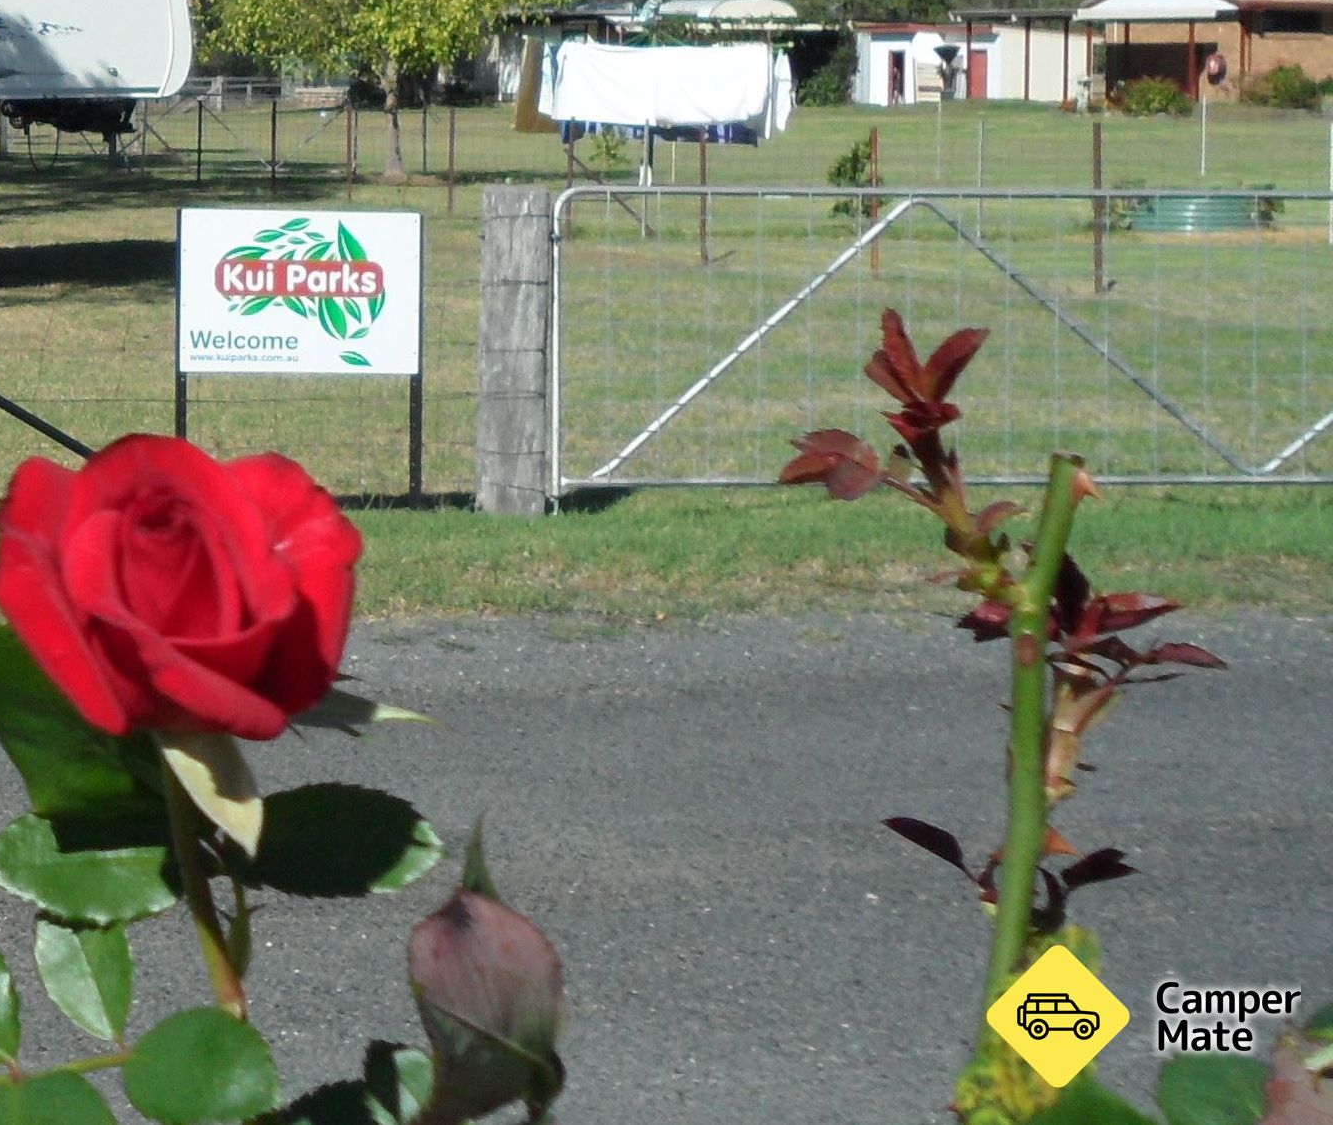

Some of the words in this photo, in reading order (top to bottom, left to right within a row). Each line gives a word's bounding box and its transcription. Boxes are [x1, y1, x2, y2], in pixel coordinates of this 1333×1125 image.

[223, 263, 274, 292] Kui
[286, 263, 377, 293] Parks
[190, 330, 298, 350] Welcome
[190, 354, 298, 362] www.kuiparks.com.au
